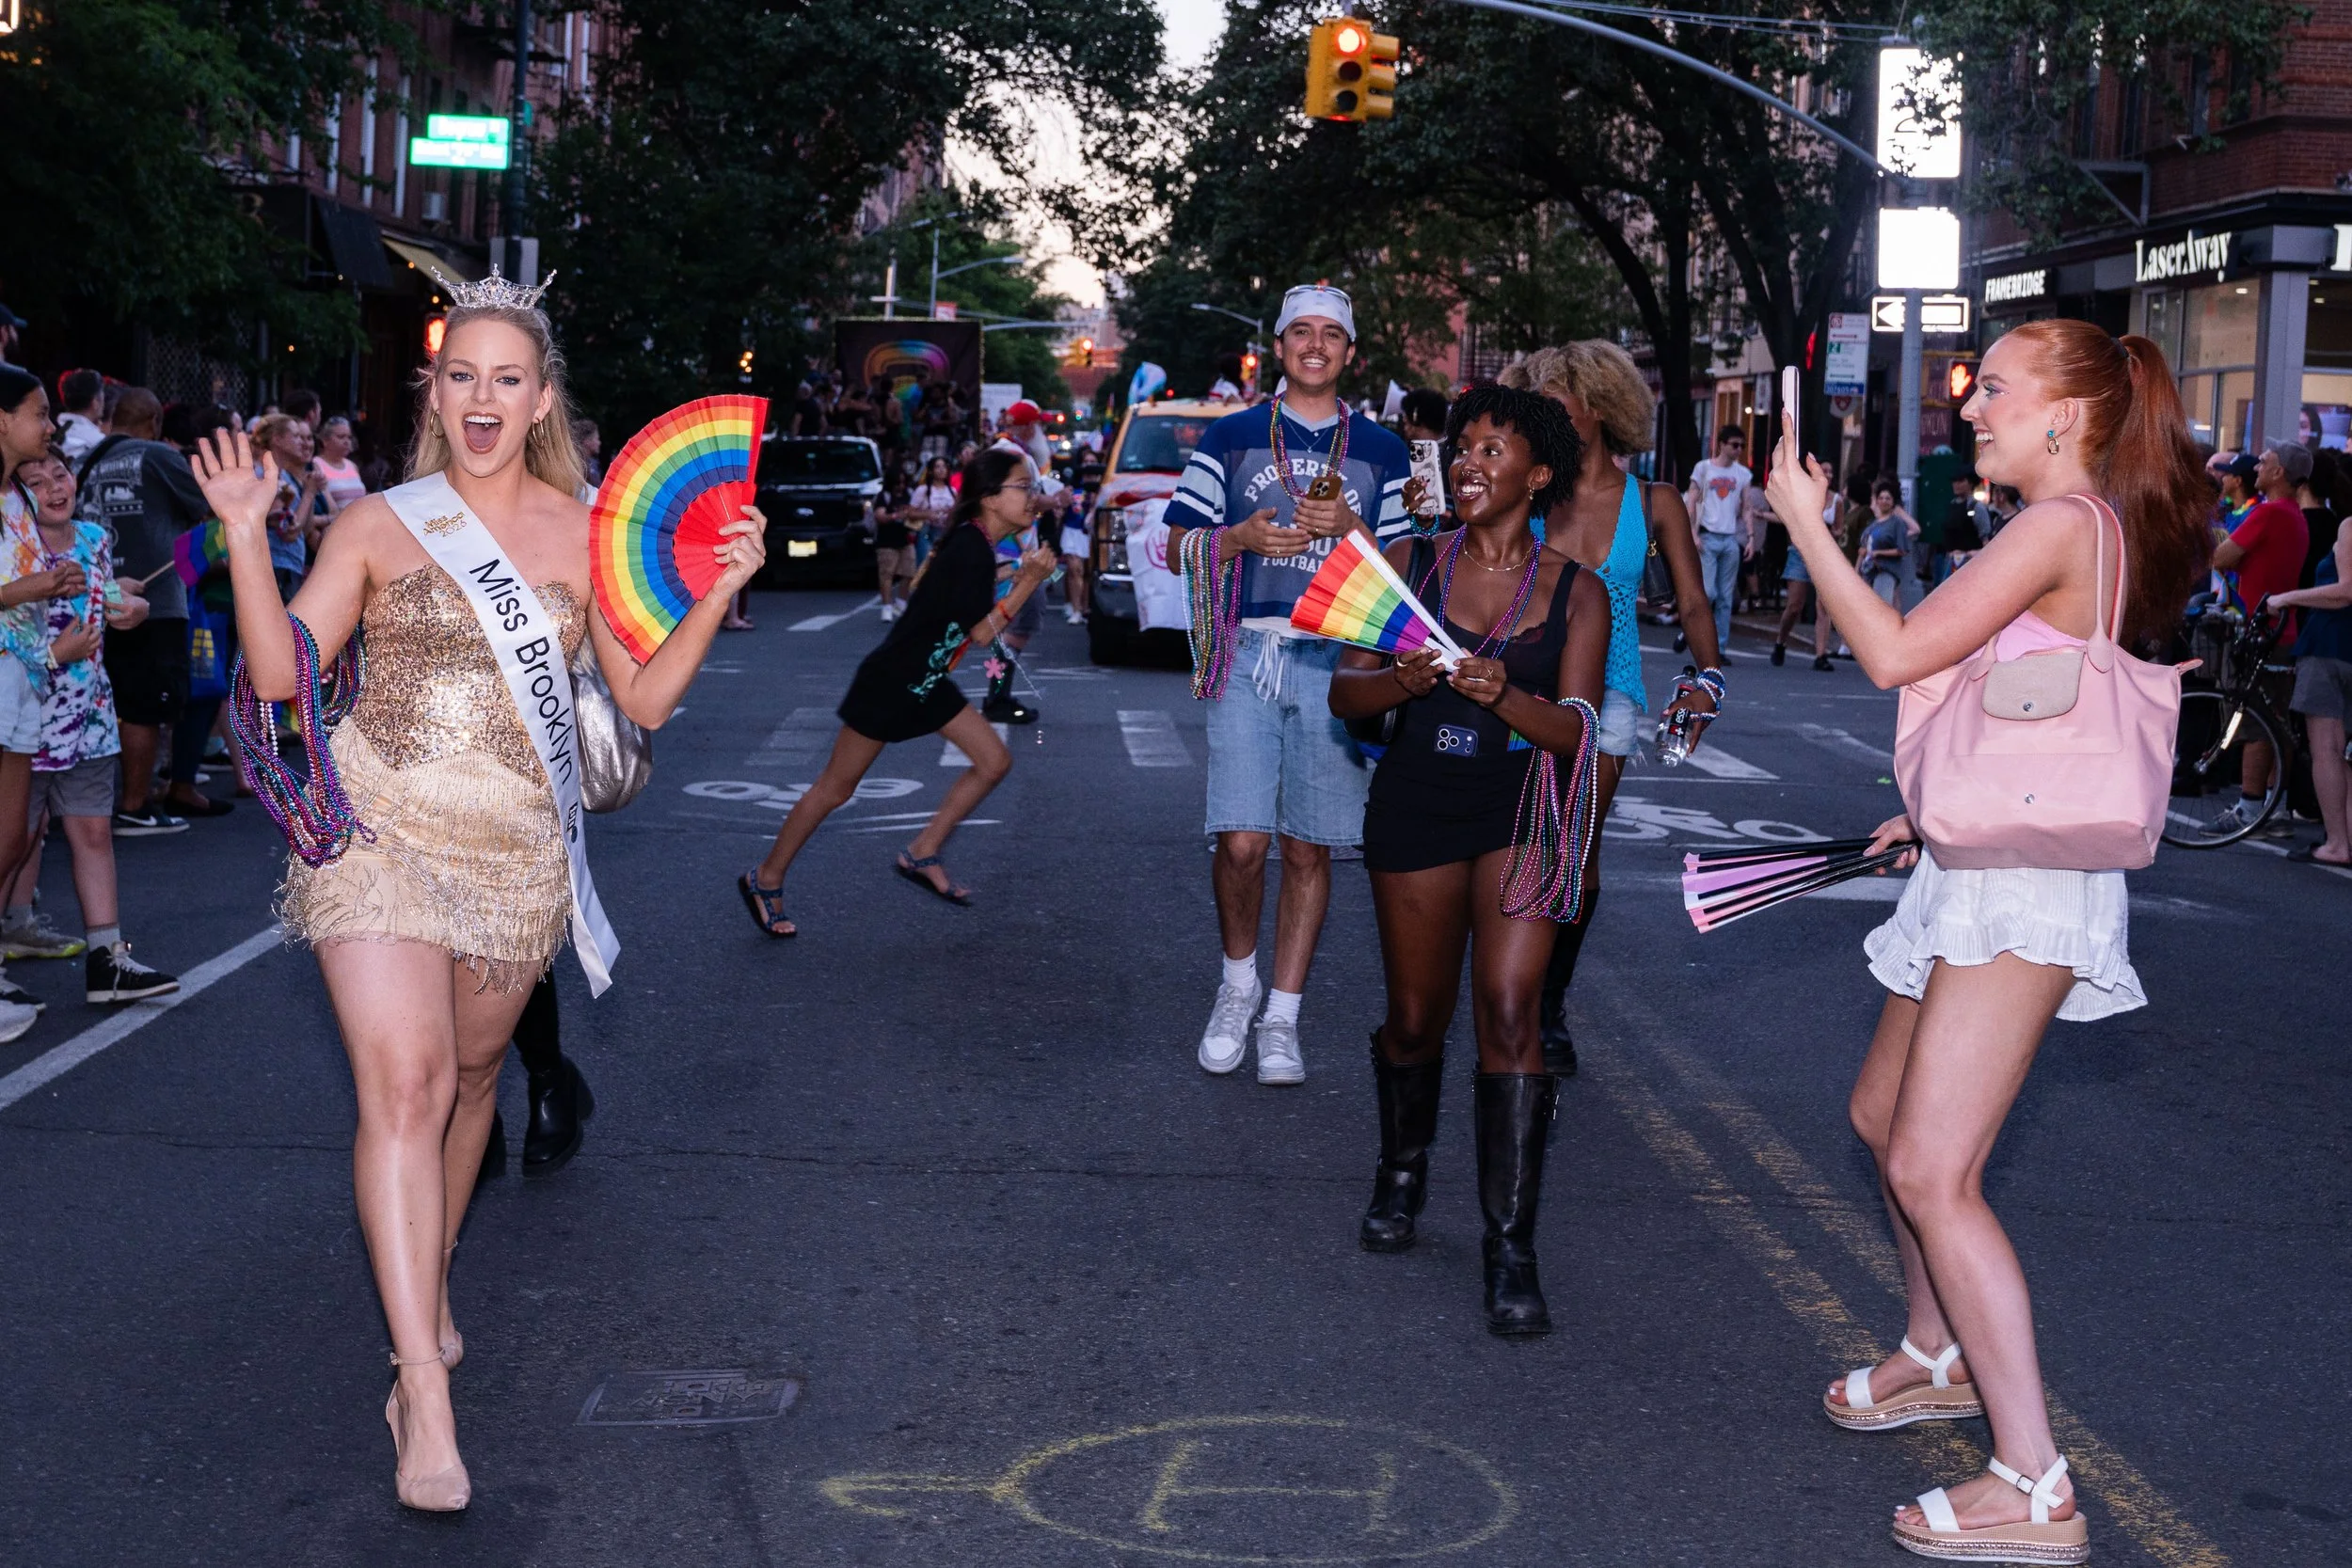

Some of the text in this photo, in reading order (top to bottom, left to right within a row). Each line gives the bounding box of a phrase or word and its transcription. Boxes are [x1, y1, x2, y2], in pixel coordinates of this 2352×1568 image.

[2135, 229, 2233, 283] LaserAway
[1985, 269, 2046, 304] FRAMEBRIDGE
[469, 559, 573, 786] Miss Brooklyn
